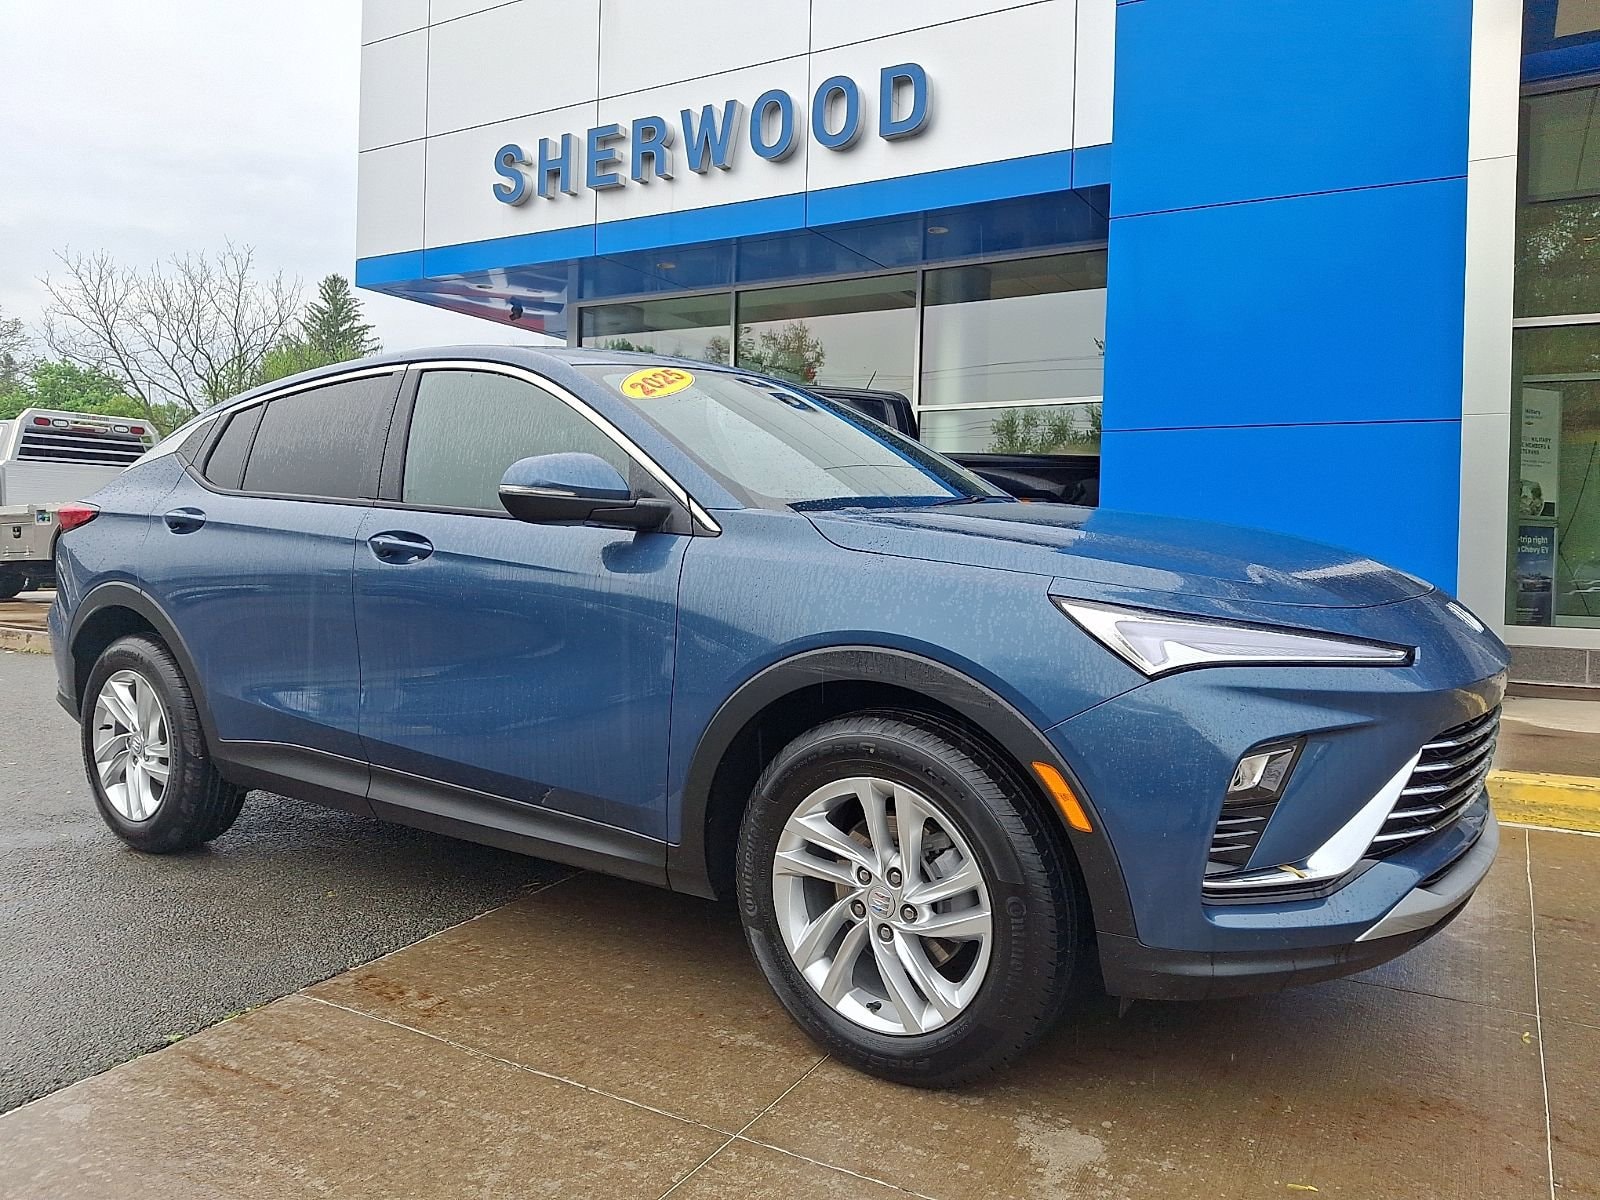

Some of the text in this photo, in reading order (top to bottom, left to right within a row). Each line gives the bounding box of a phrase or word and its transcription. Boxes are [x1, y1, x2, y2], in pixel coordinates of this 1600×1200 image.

[492, 62, 933, 206] SHERWOOD
[629, 368, 687, 397] 2025
[1532, 535, 1548, 545] right
[1520, 545, 1541, 555] Chevy
